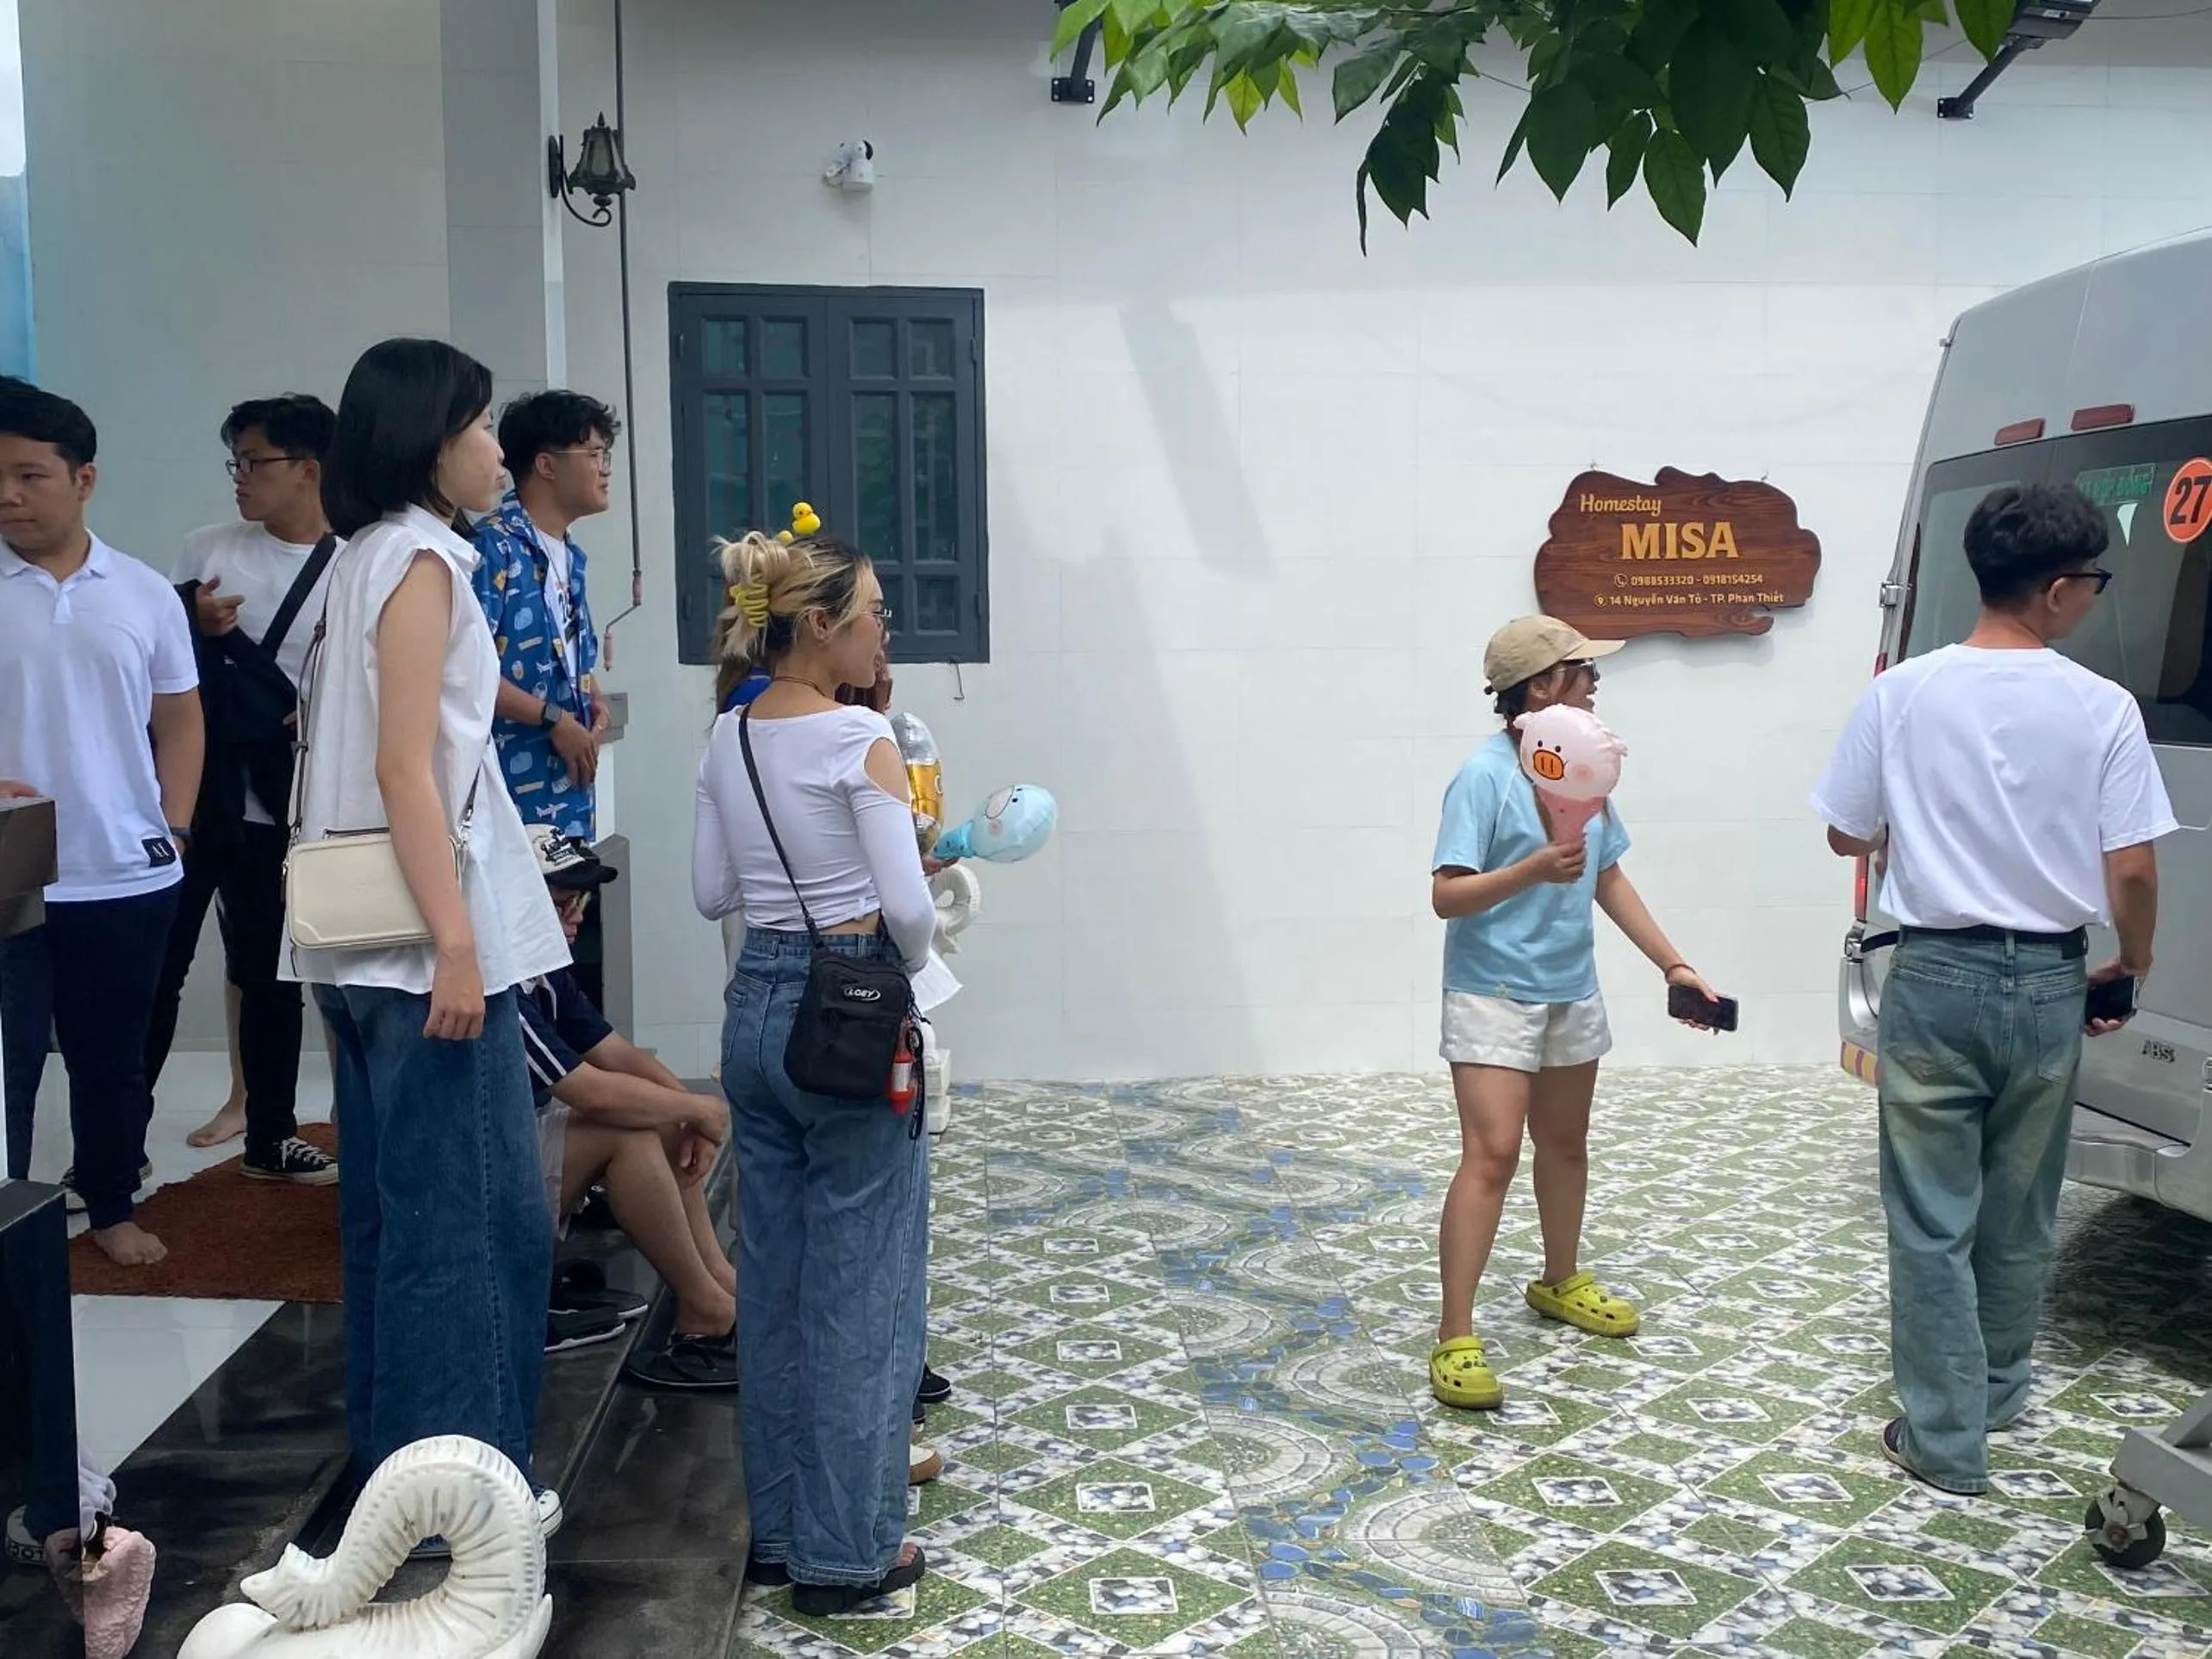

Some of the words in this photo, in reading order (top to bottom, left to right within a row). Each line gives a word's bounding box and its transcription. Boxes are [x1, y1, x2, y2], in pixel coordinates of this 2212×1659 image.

[1580, 494, 1662, 517] Homestay
[2170, 475, 2212, 525] 27
[1620, 521, 1740, 560] MISA
[1610, 596, 1621, 605] 14
[1728, 593, 1755, 603] Phan
